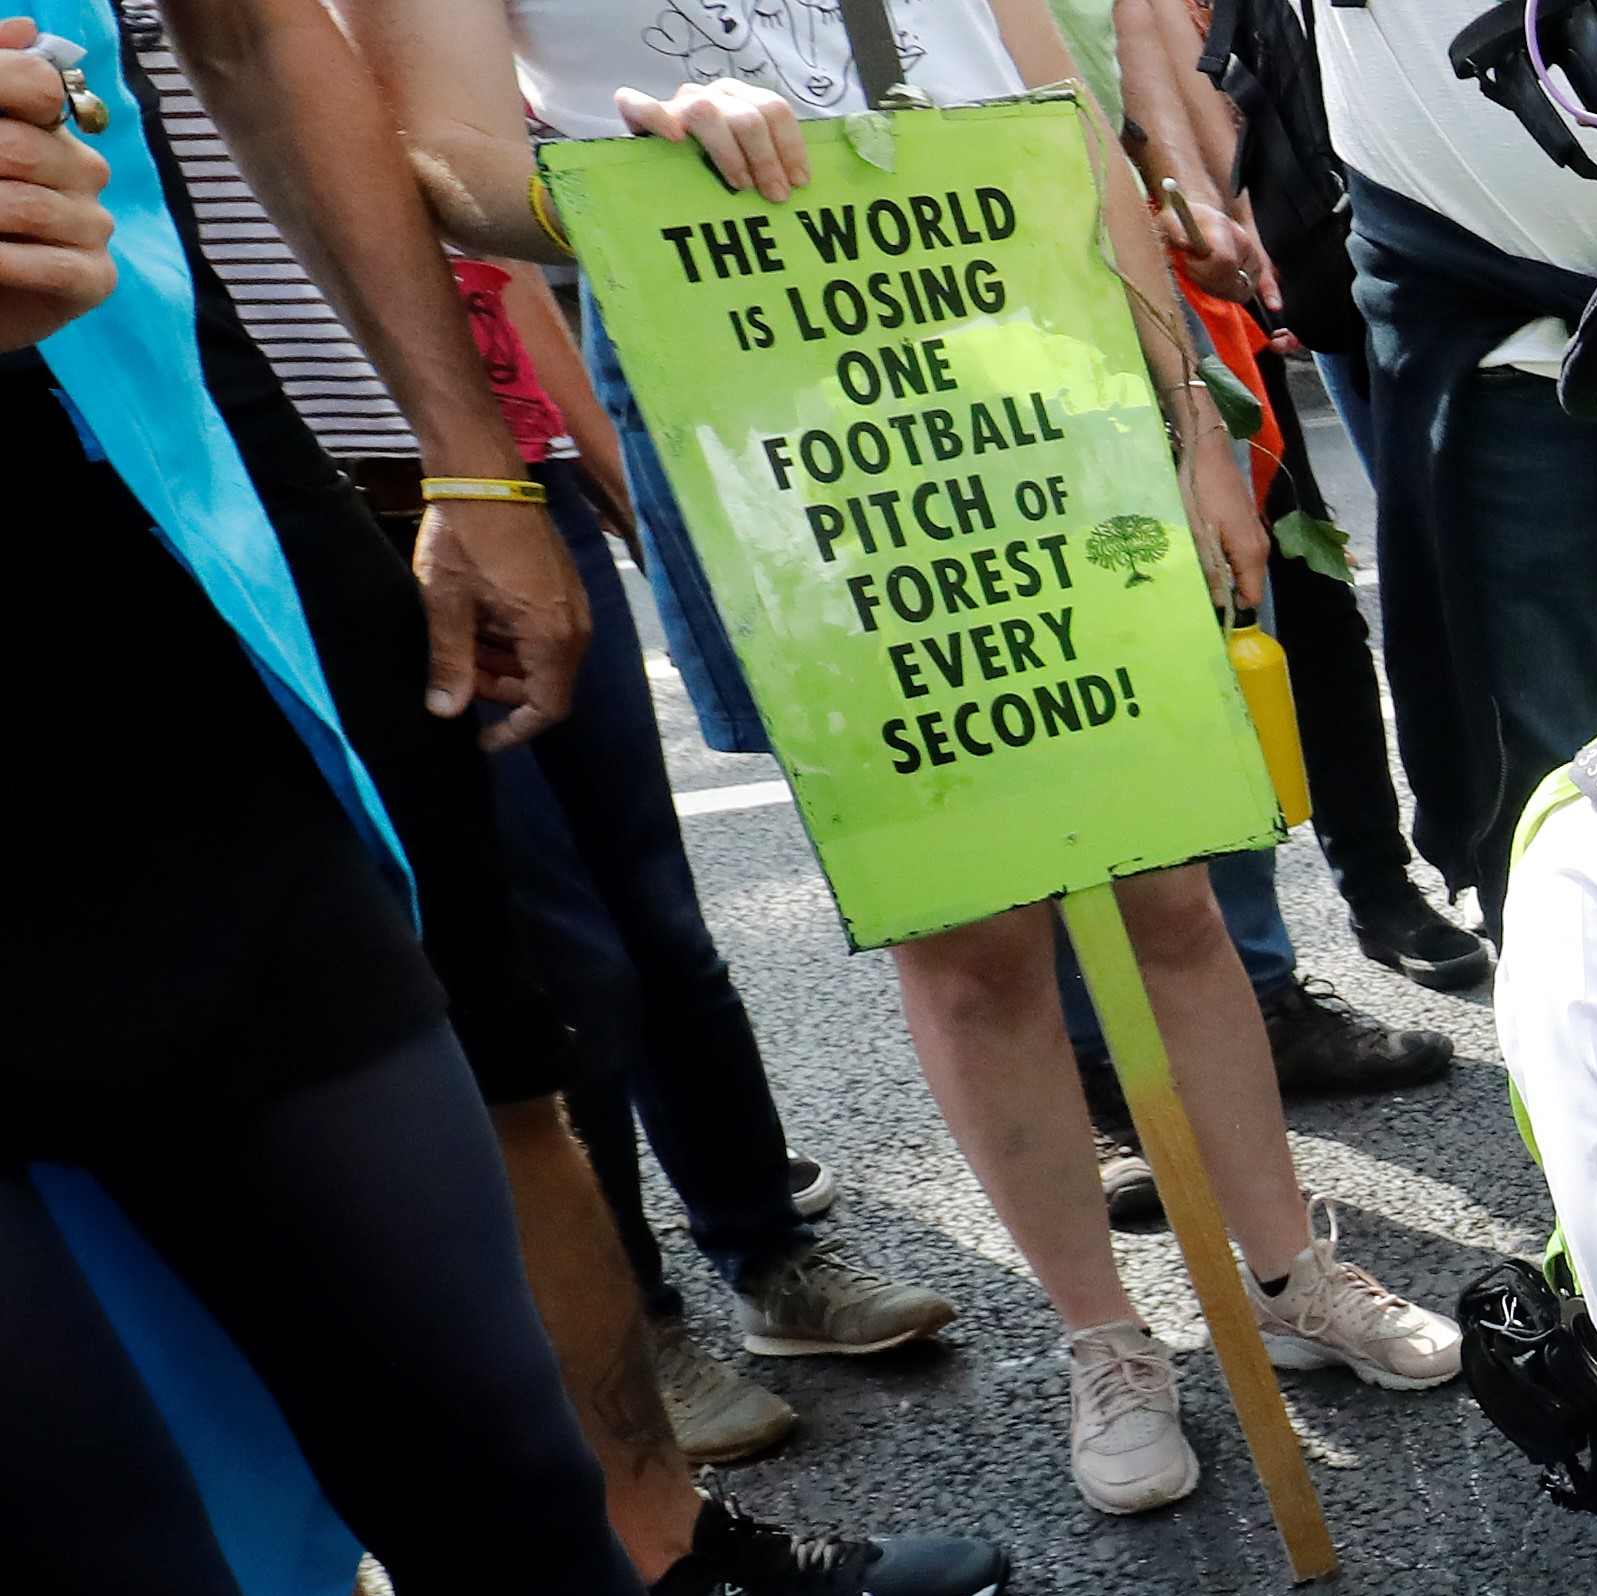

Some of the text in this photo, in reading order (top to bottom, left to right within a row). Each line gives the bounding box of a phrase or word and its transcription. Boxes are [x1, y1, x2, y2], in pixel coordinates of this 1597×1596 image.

[659, 186, 1017, 284] THE WORLD
[727, 258, 1006, 352] IS LOSING
[836, 338, 959, 407] ONE
[761, 392, 1065, 492] FOOTBALL
[804, 473, 1069, 564] PITCH OF
[845, 533, 1074, 633] FOREST
[887, 606, 1078, 700] EVERY
[881, 666, 1141, 776] SECOND!
